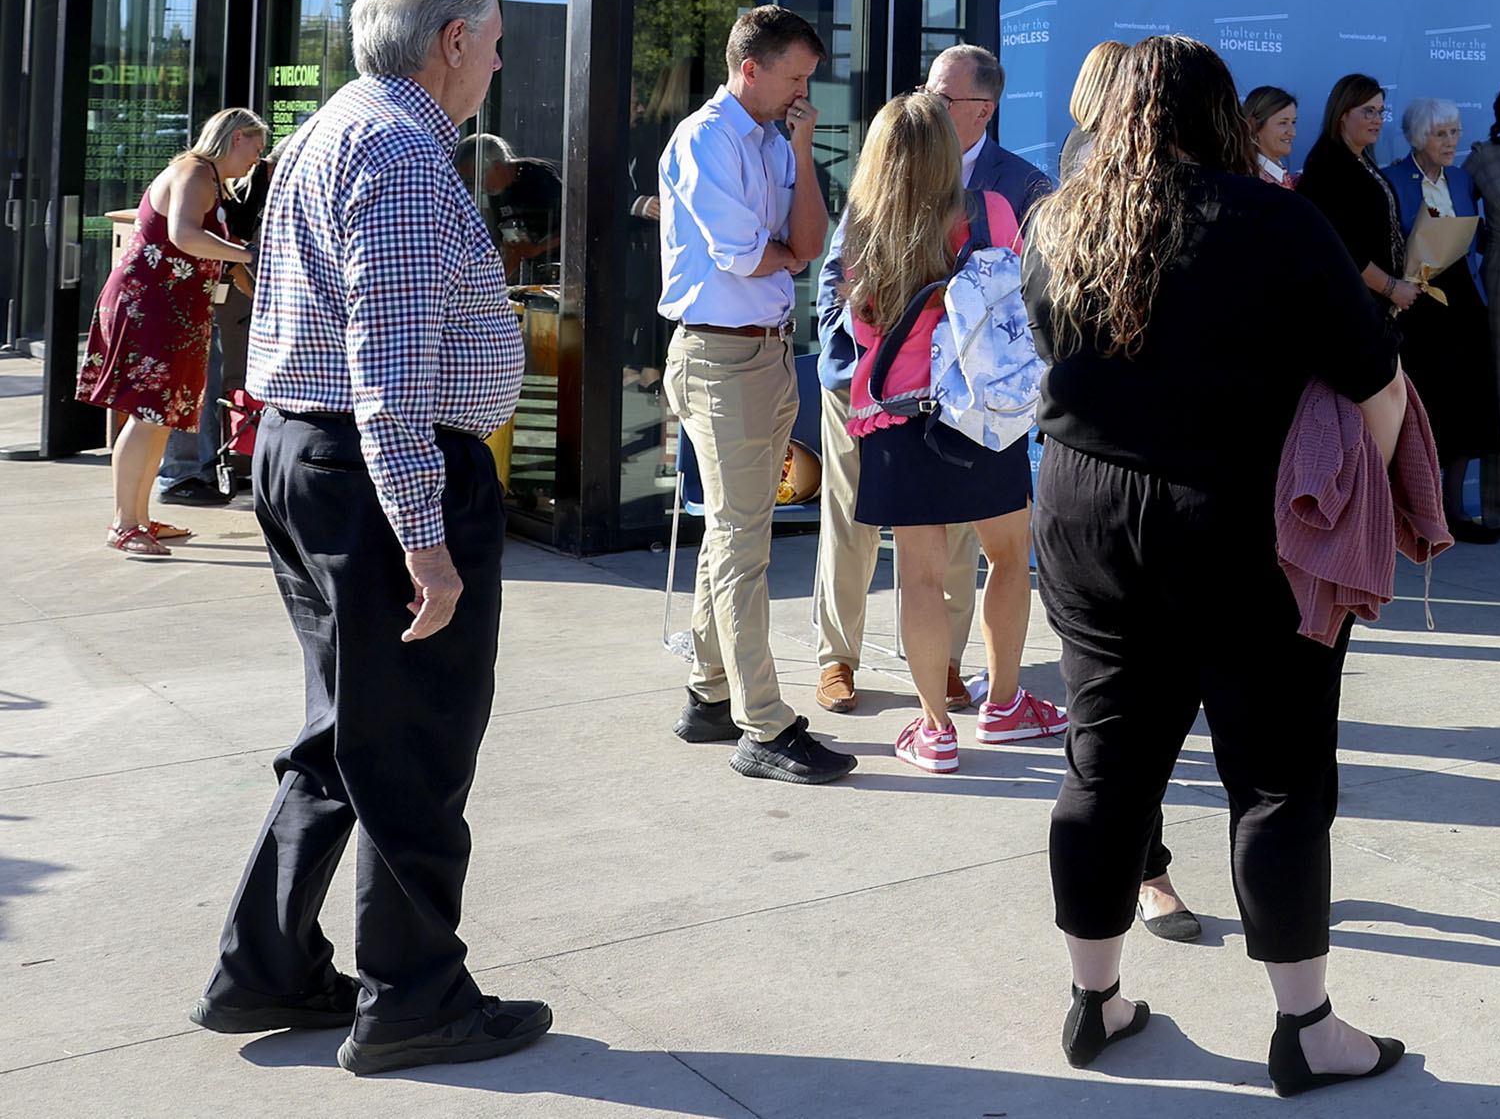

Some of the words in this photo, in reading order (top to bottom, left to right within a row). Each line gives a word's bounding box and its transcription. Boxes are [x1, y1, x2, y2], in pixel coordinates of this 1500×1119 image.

[1032, 18, 1050, 30] the
[1220, 25, 1260, 39] shelter
[1264, 28, 1282, 41] the
[1220, 39, 1282, 53] HOMELESS
[1430, 37, 1466, 49] shelter
[1469, 38, 1487, 50] the
[1430, 50, 1486, 61] HOMELESS
